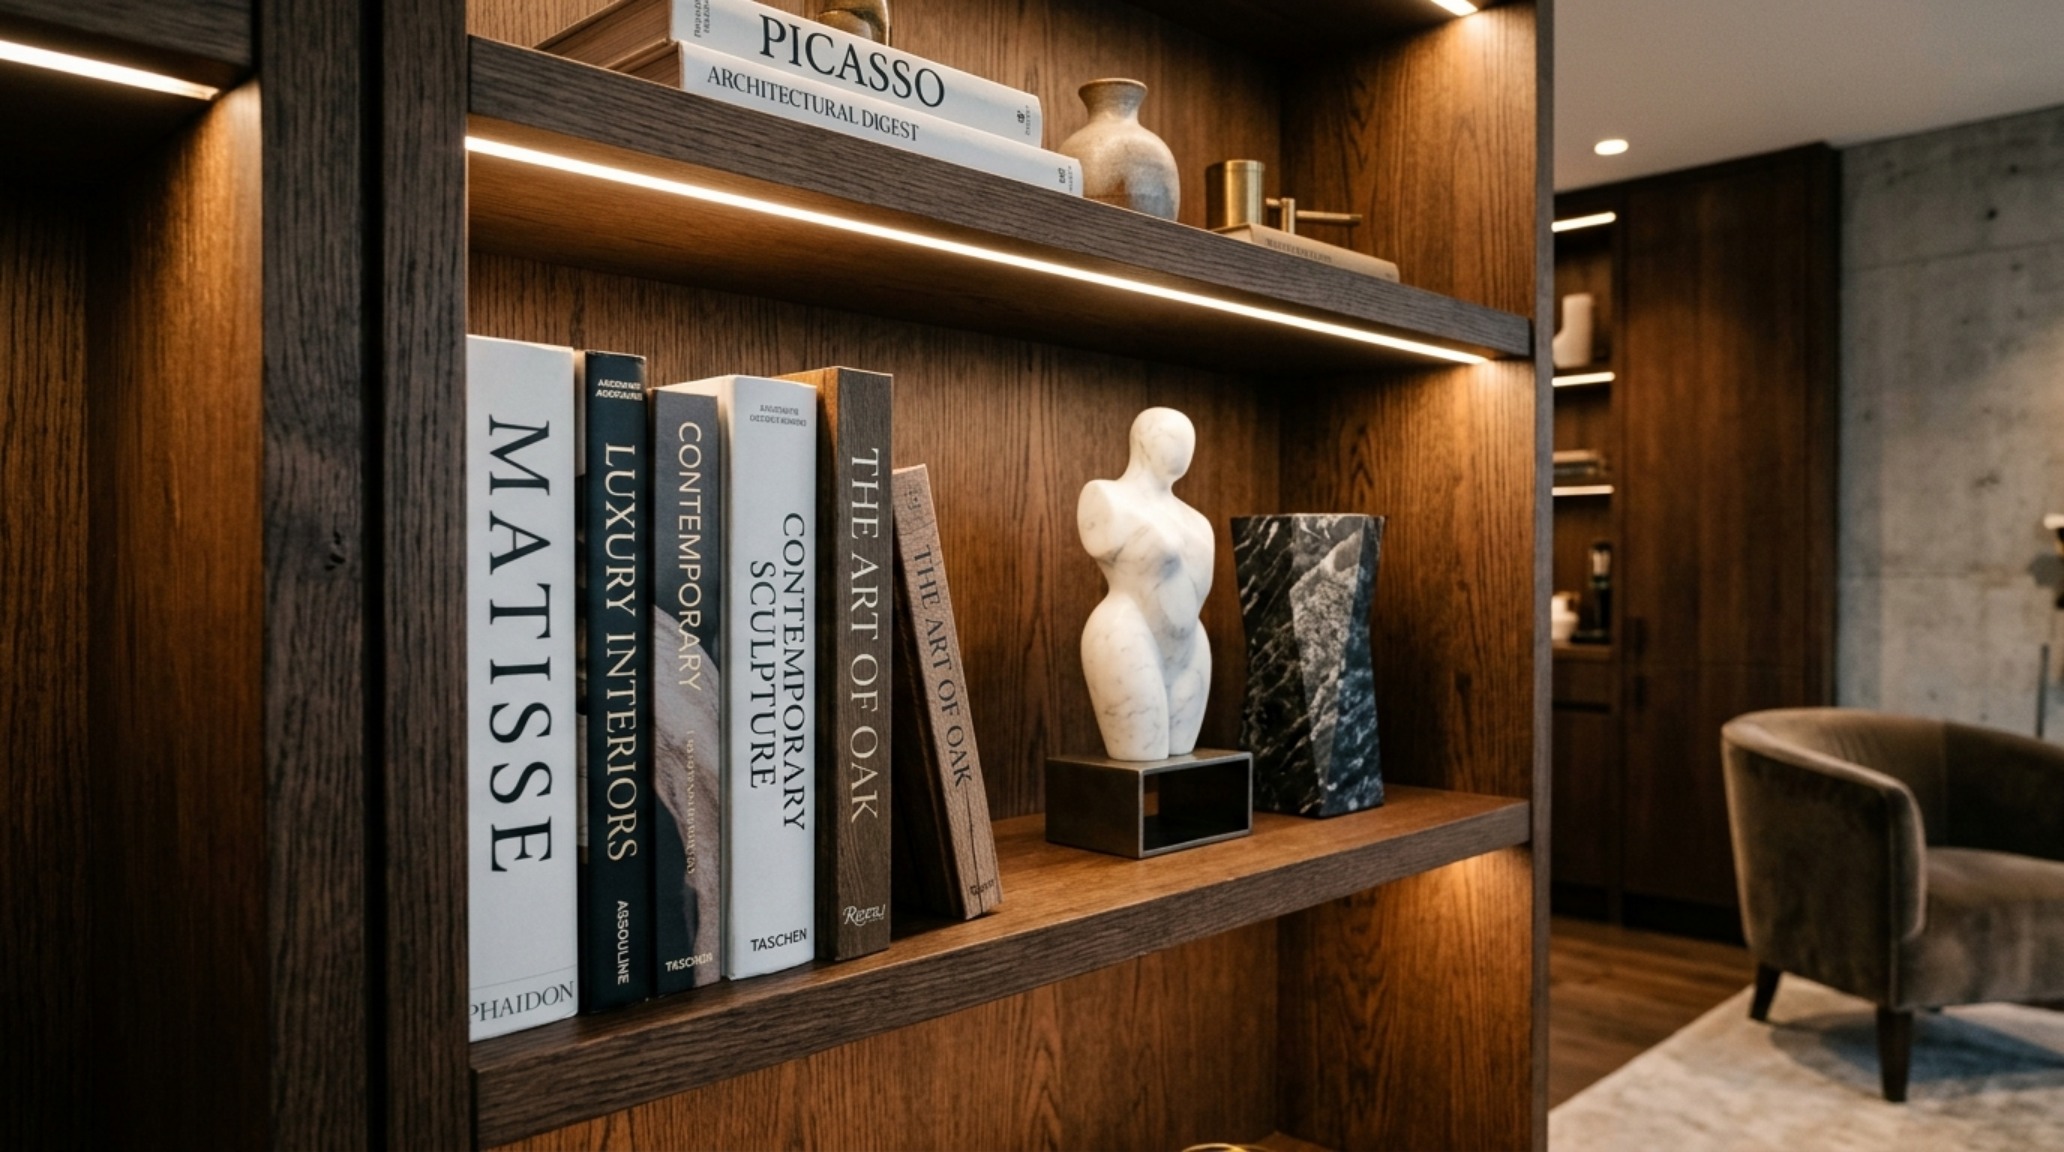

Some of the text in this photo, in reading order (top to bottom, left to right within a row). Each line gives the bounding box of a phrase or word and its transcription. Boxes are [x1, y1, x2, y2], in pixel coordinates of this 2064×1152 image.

[707, 65, 920, 142] ARCHITECTURAL DIGEST
[759, 14, 944, 108] PICASSO
[489, 414, 553, 873] MATISSE
[604, 443, 638, 862] LUXURY INTERIORS
[678, 421, 702, 691] CONTEMPORARY
[749, 560, 776, 789] SCULPTURE
[782, 512, 806, 831] CONTEMPORARY
[850, 447, 879, 823] THE ART OF OAK
[913, 544, 972, 788] THE ART OF OAK
[750, 928, 808, 952] TASCHEN
